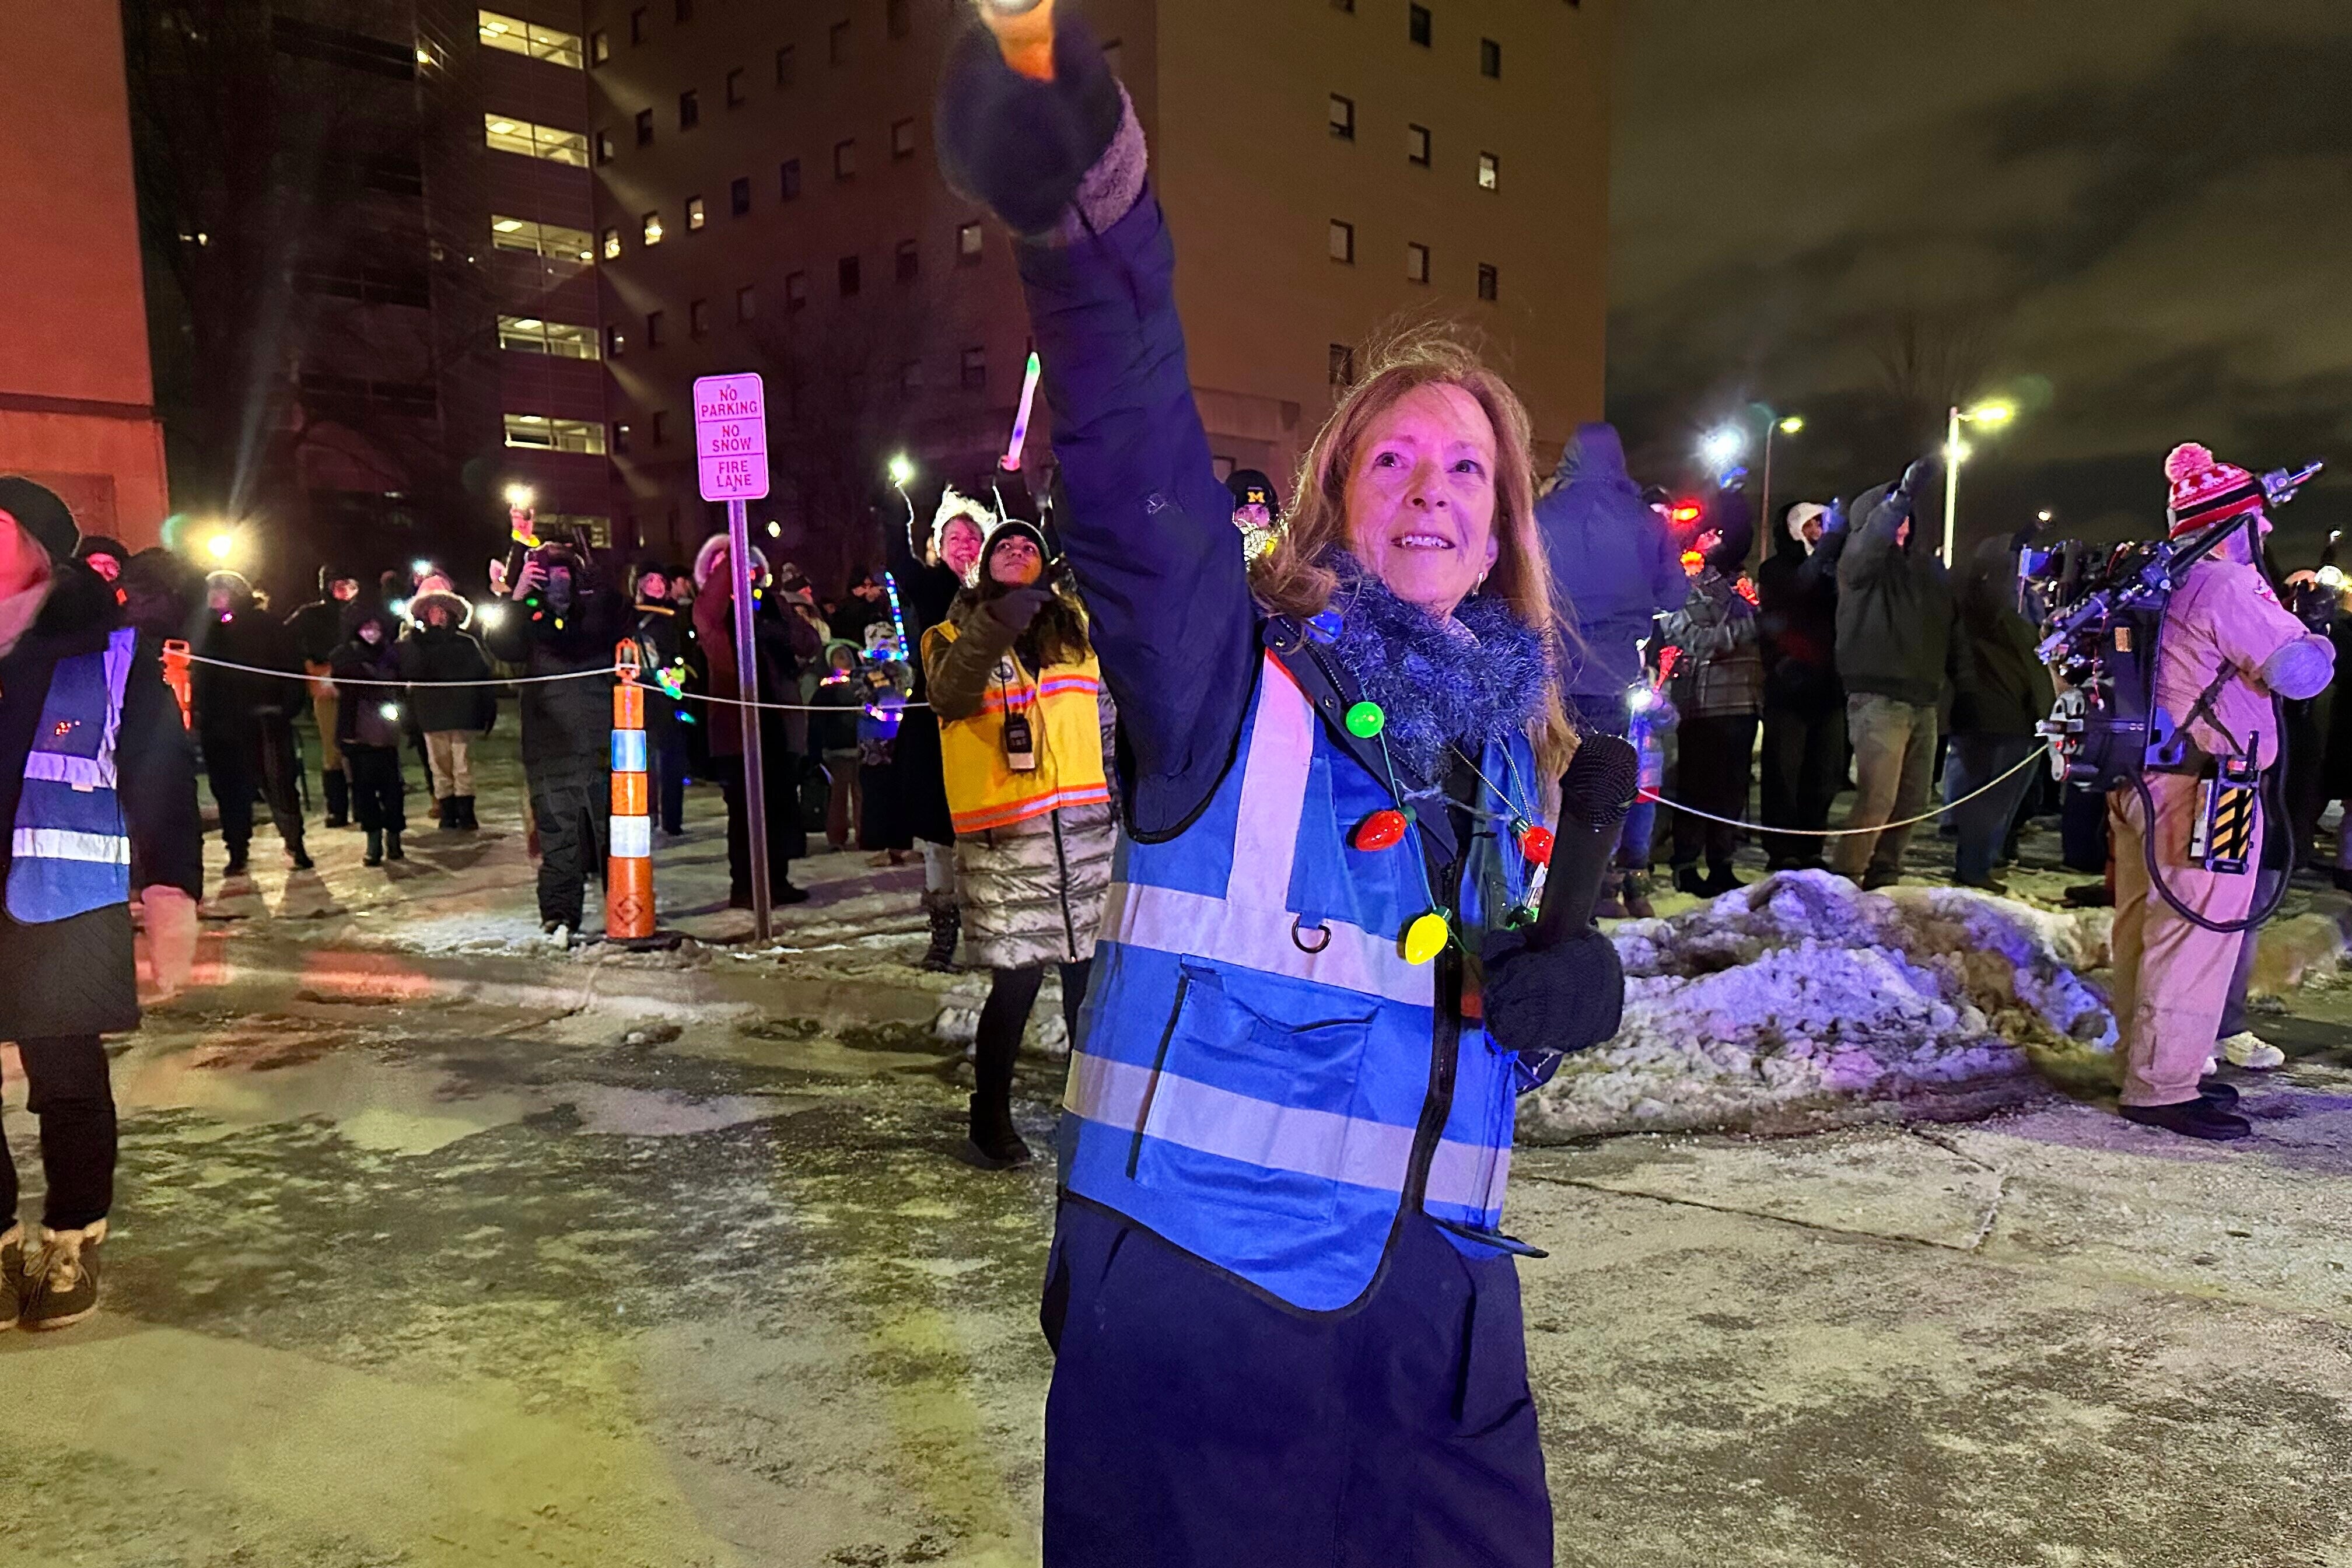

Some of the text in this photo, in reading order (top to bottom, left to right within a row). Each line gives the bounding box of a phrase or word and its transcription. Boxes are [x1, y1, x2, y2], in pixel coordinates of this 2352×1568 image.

[719, 388, 737, 401] NO
[701, 401, 757, 417] PARKING
[722, 425, 740, 438] NO
[712, 437, 751, 452] SNOW
[719, 460, 748, 474] FIRE
[716, 474, 752, 487] LANE
[1247, 491, 1266, 503] M
